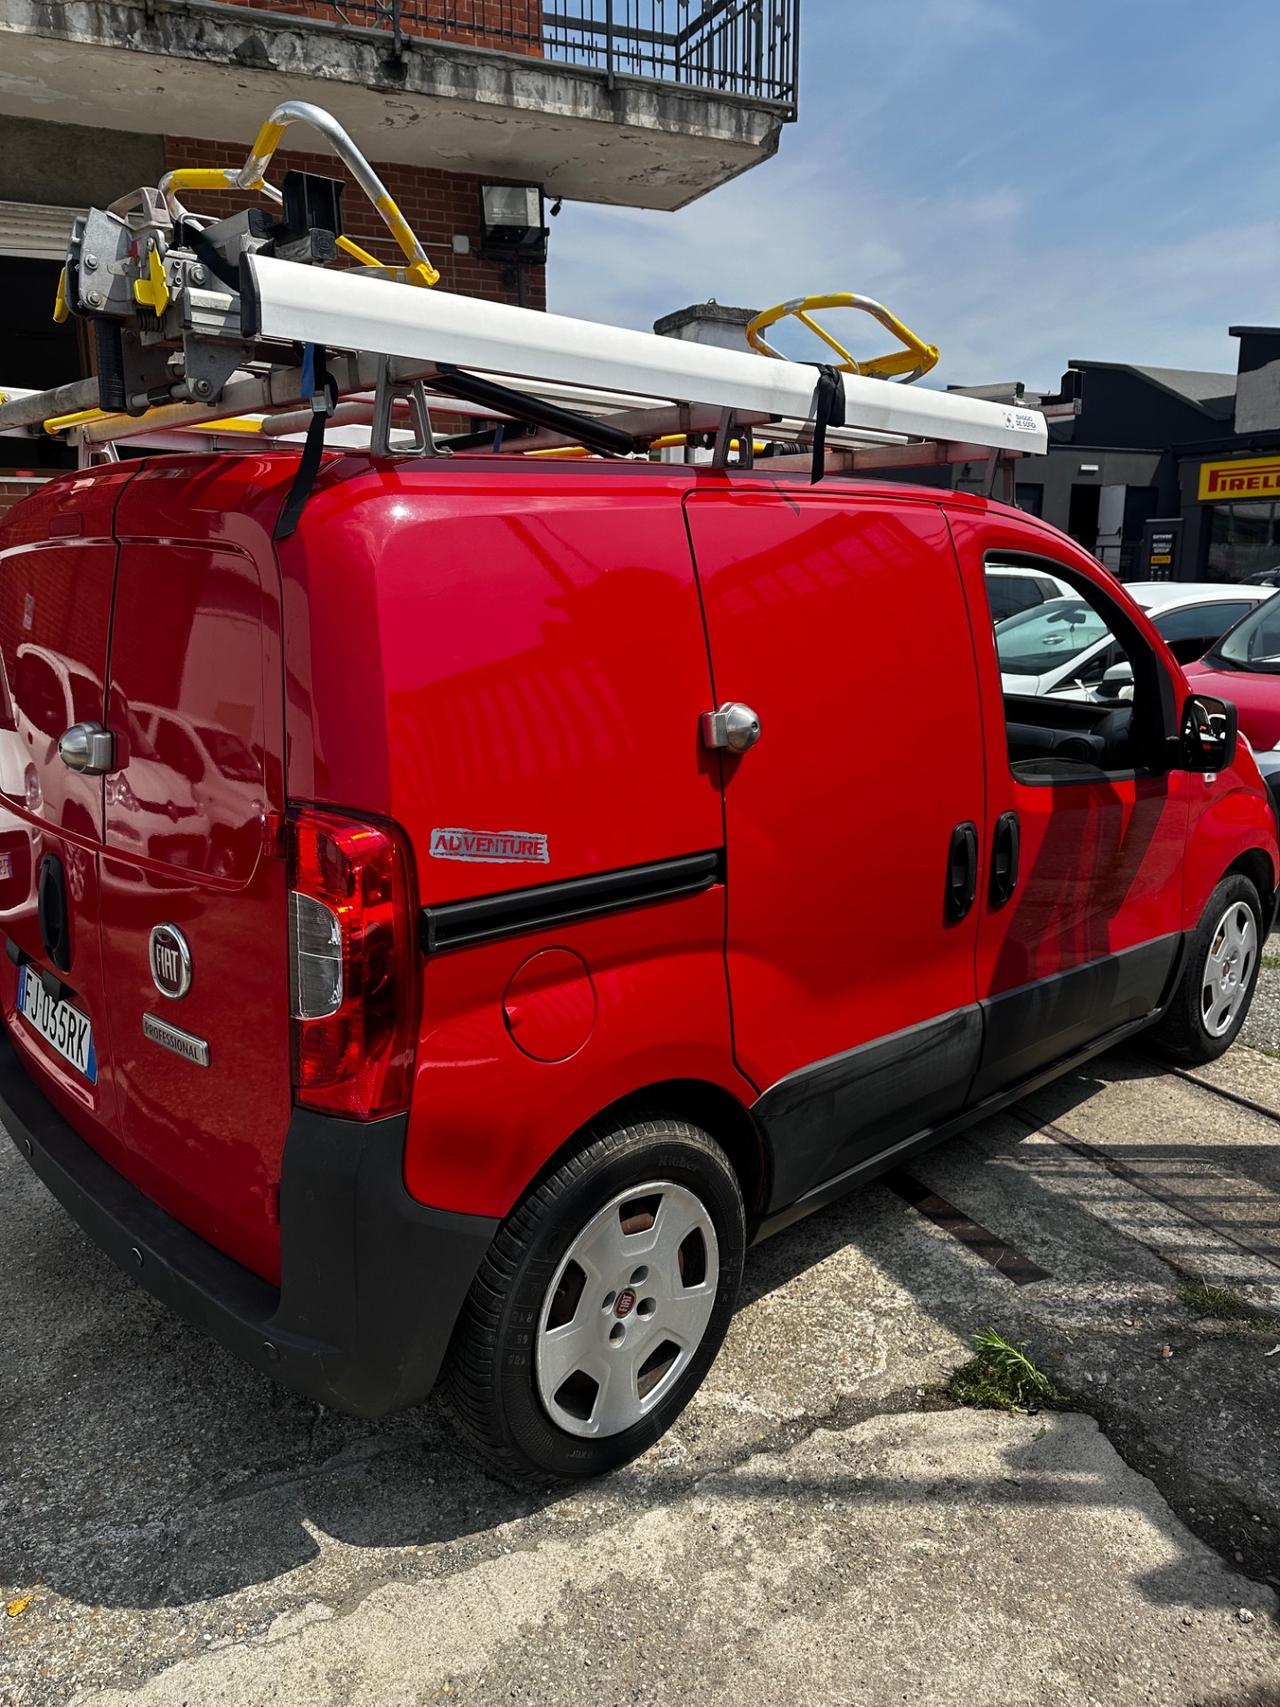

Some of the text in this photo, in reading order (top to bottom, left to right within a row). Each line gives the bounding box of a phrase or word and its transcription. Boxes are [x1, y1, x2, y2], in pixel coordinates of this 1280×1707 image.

[434, 834, 544, 856] ADVENTURE
[156, 943, 178, 982] FIAT
[144, 1021, 199, 1060] PROFESSIONAL
